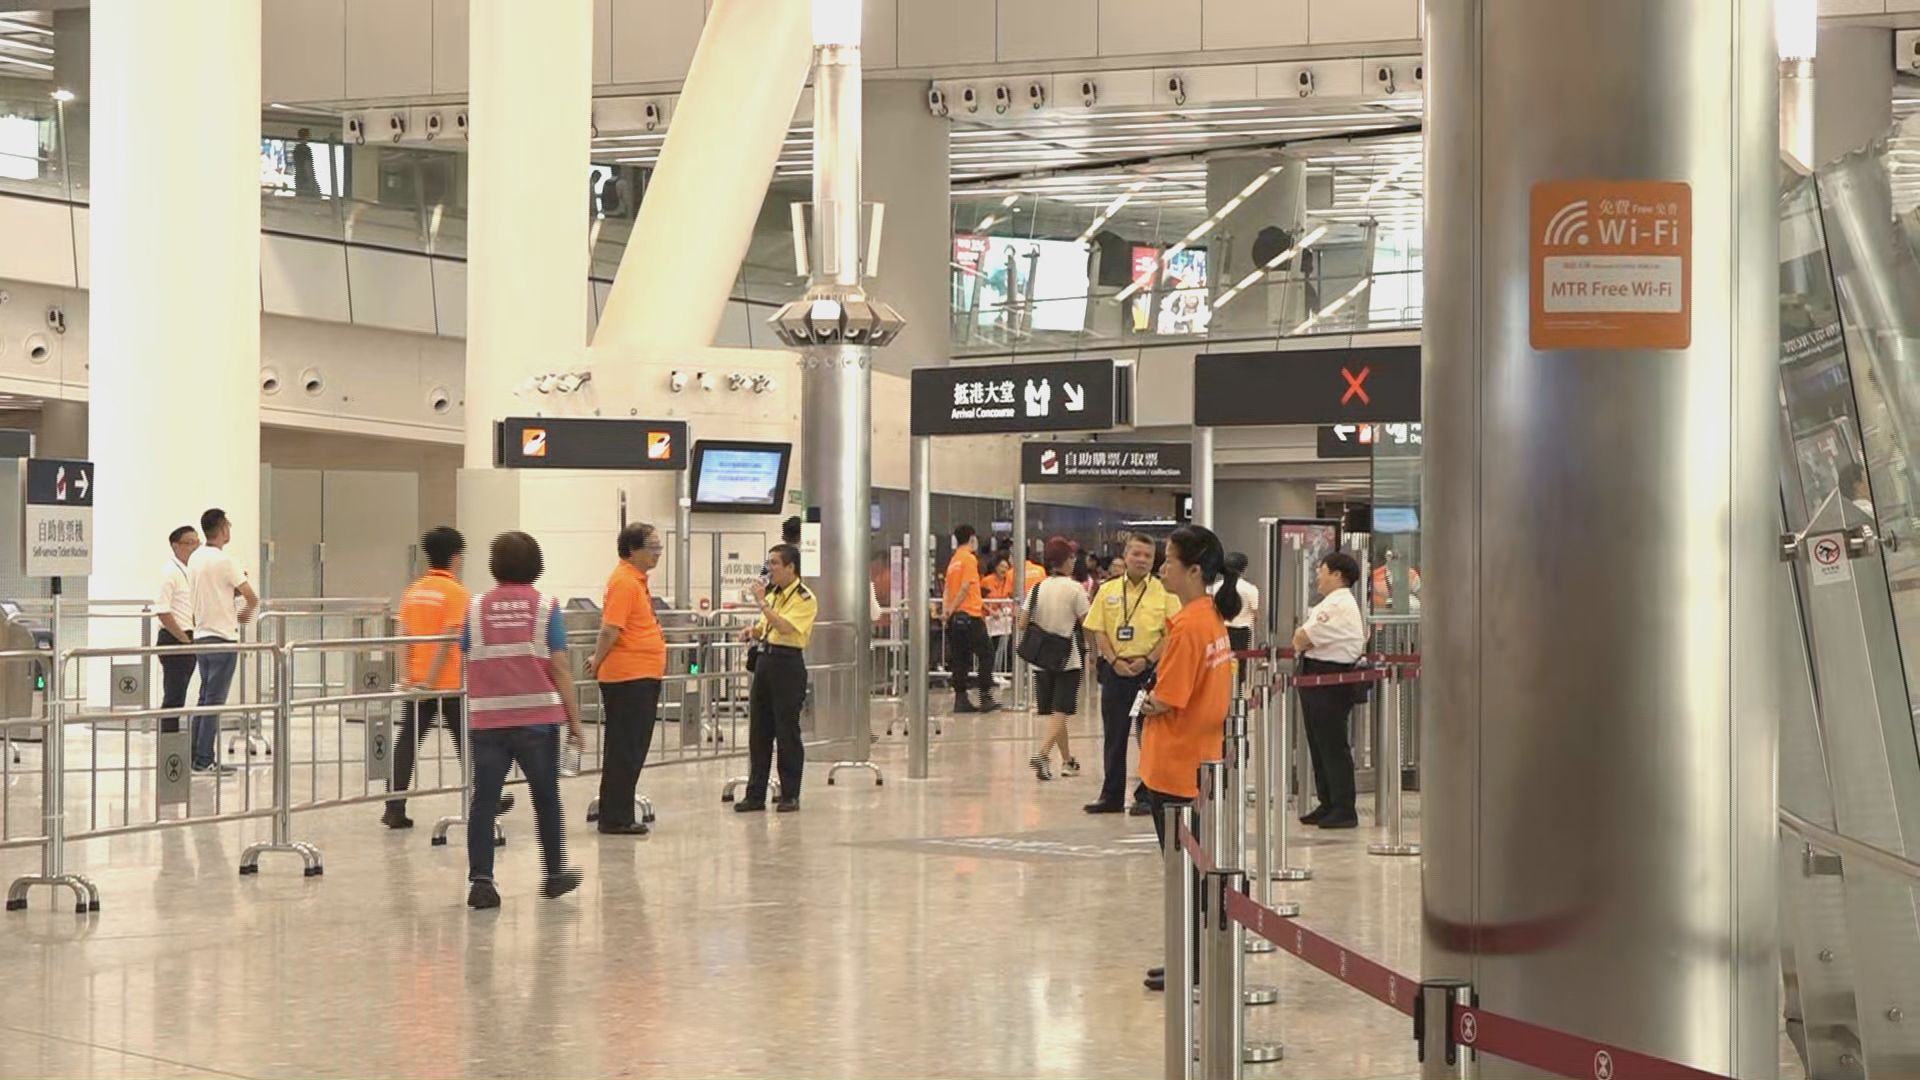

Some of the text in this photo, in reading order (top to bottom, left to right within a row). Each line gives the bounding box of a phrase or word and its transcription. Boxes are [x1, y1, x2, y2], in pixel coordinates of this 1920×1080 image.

[1597, 219, 1678, 245] Wi-Fi
[1551, 281, 1672, 297] MTR Free Wi-Fi
[951, 407, 1016, 419] Arrival Concourse
[1065, 467, 1099, 476] Self-service
[1101, 467, 1118, 476] ticket
[1119, 468, 1146, 477] purchase
[1151, 467, 1181, 476] collection
